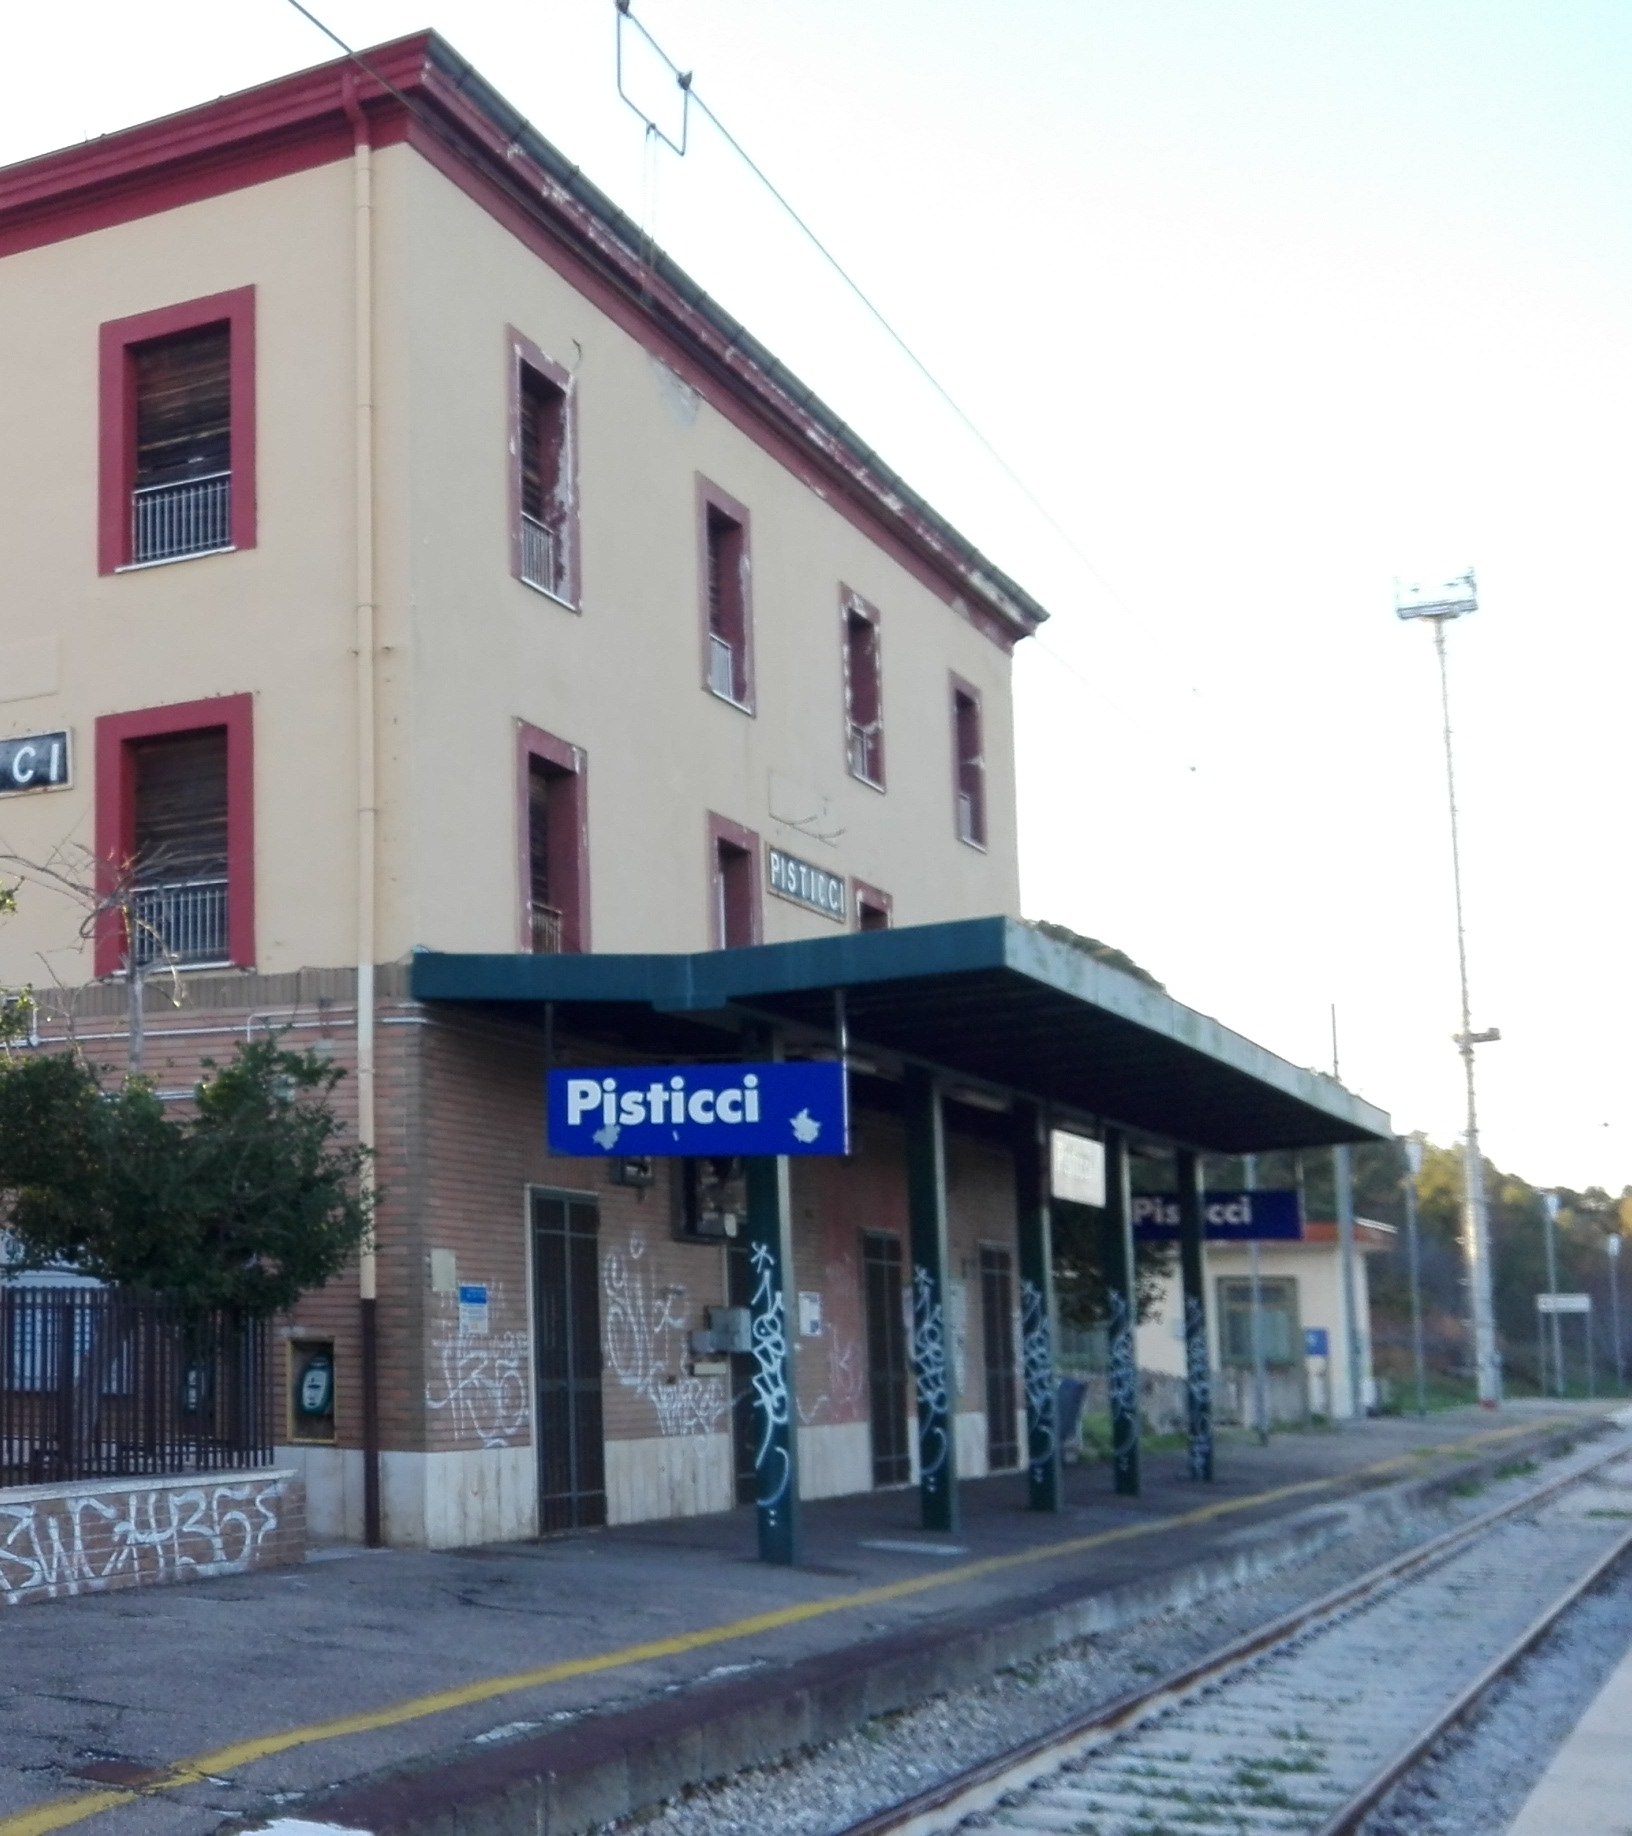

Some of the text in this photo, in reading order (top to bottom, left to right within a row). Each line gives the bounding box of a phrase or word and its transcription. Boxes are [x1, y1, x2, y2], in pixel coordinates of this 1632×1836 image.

[770, 851, 845, 914] PISTICCI
[567, 1073, 760, 1126] Pisticci
[1131, 1195, 1252, 1226] Piscci
